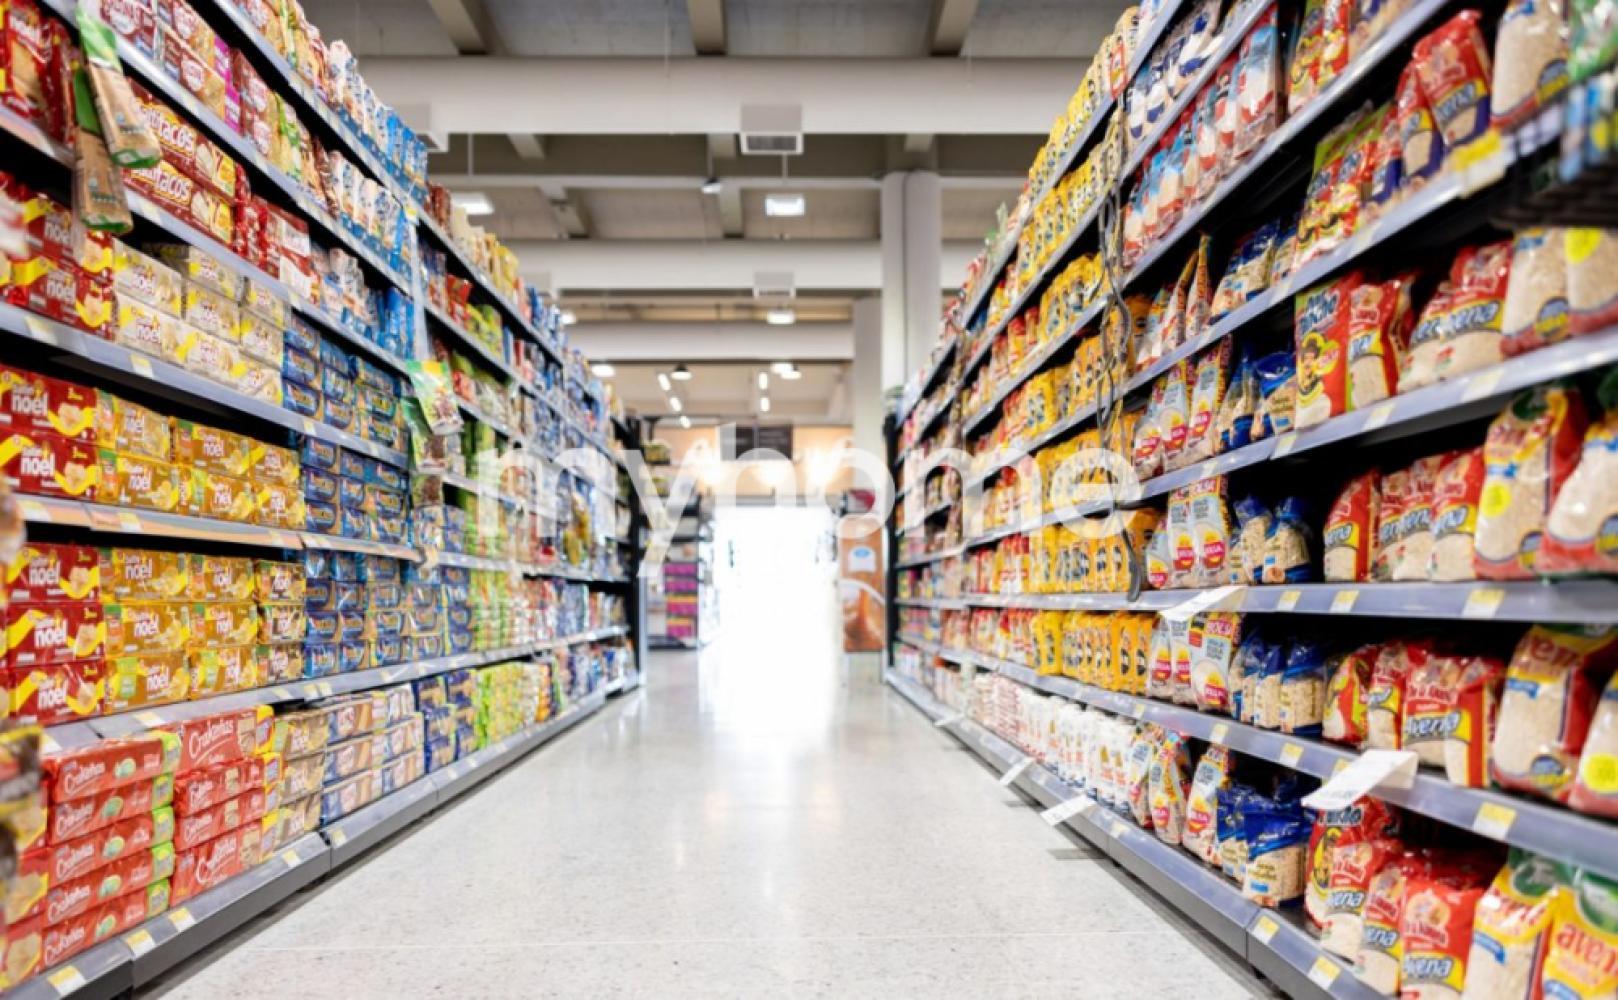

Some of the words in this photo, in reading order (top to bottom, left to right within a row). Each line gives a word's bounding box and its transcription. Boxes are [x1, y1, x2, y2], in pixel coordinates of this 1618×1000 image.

[11, 392, 49, 417] noel
[21, 453, 55, 477] noel
[29, 560, 61, 585] noel
[34, 618, 68, 648] noel
